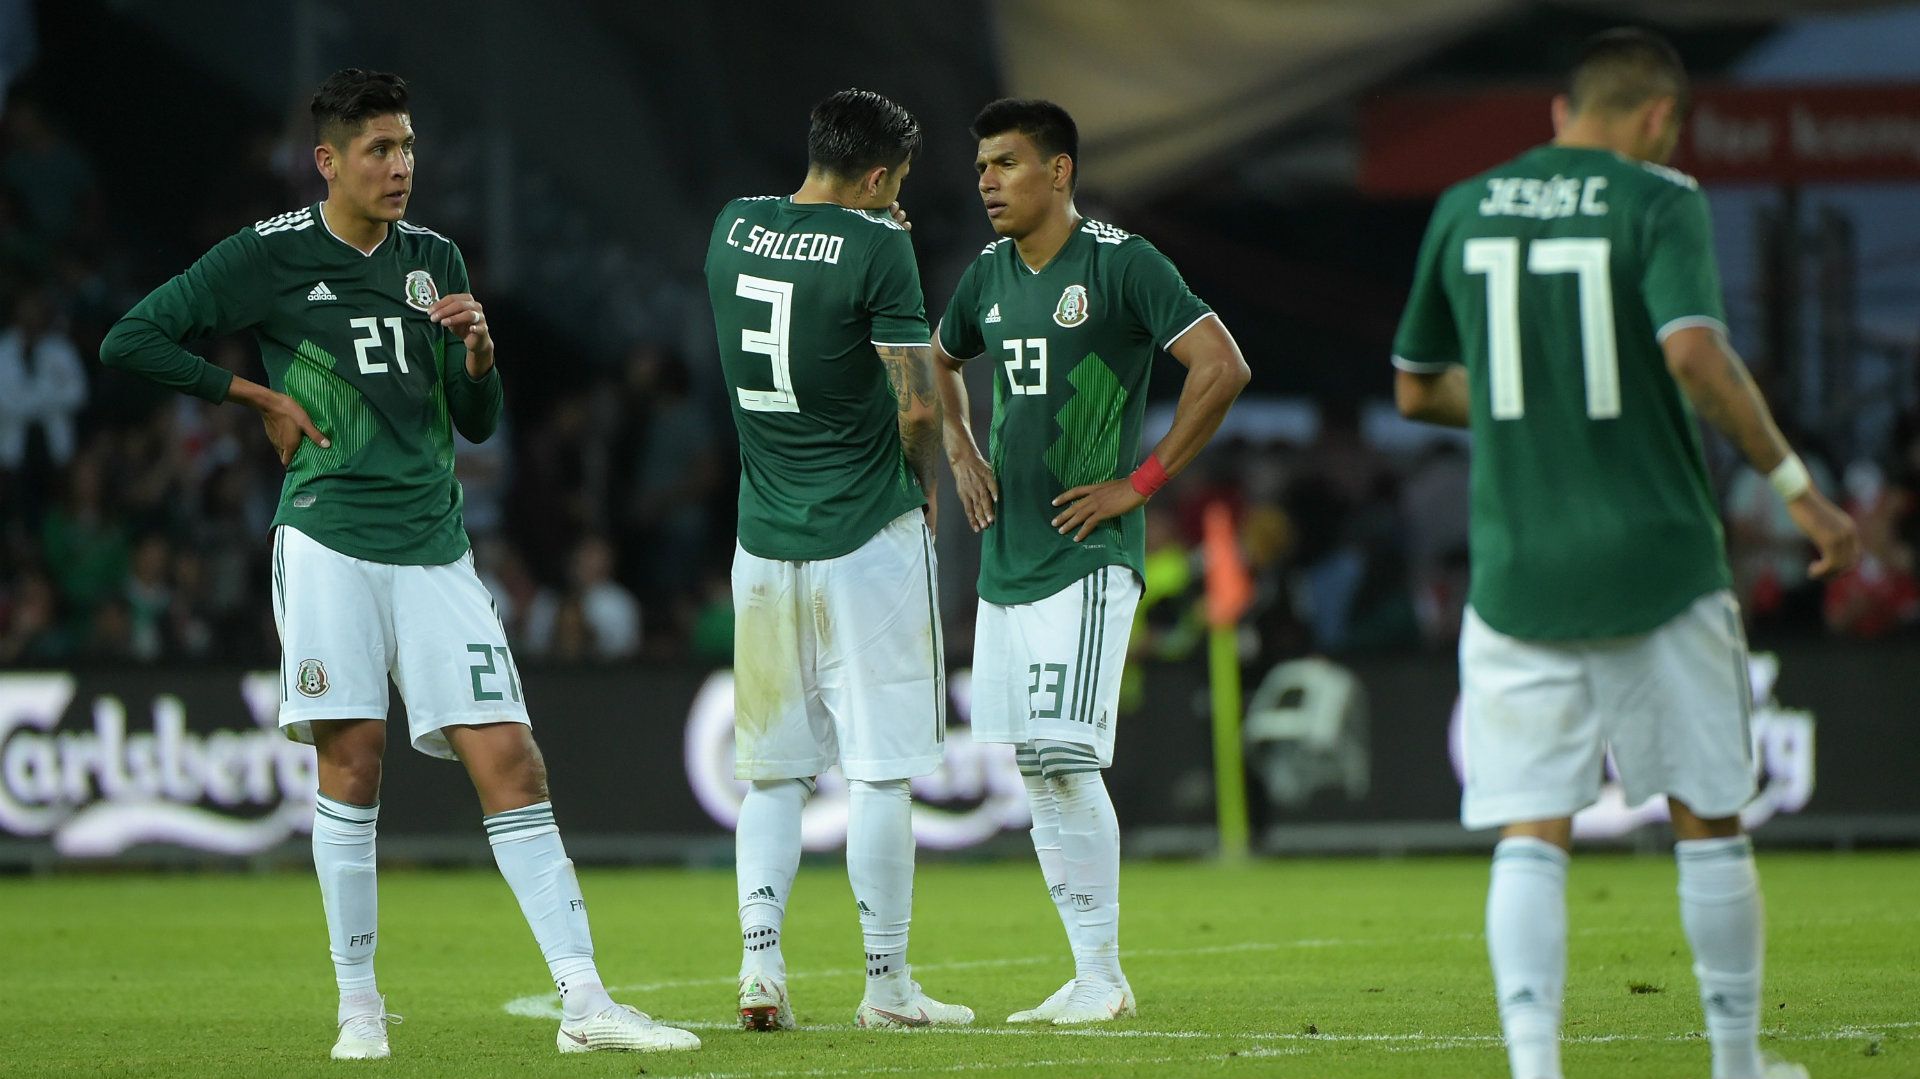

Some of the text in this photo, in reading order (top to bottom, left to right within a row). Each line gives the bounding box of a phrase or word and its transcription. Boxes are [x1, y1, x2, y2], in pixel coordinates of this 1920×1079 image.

[743, 225, 844, 264] SALCEDO
[307, 293, 337, 301] adidas
[350, 317, 409, 375] 21
[735, 273, 800, 413] 3
[1463, 236, 1622, 421] 17
[1002, 338, 1047, 395] 23
[466, 643, 520, 702] 21
[1028, 663, 1068, 720] 23
[1070, 893, 1093, 905] FMF
[350, 931, 375, 946] FMF
